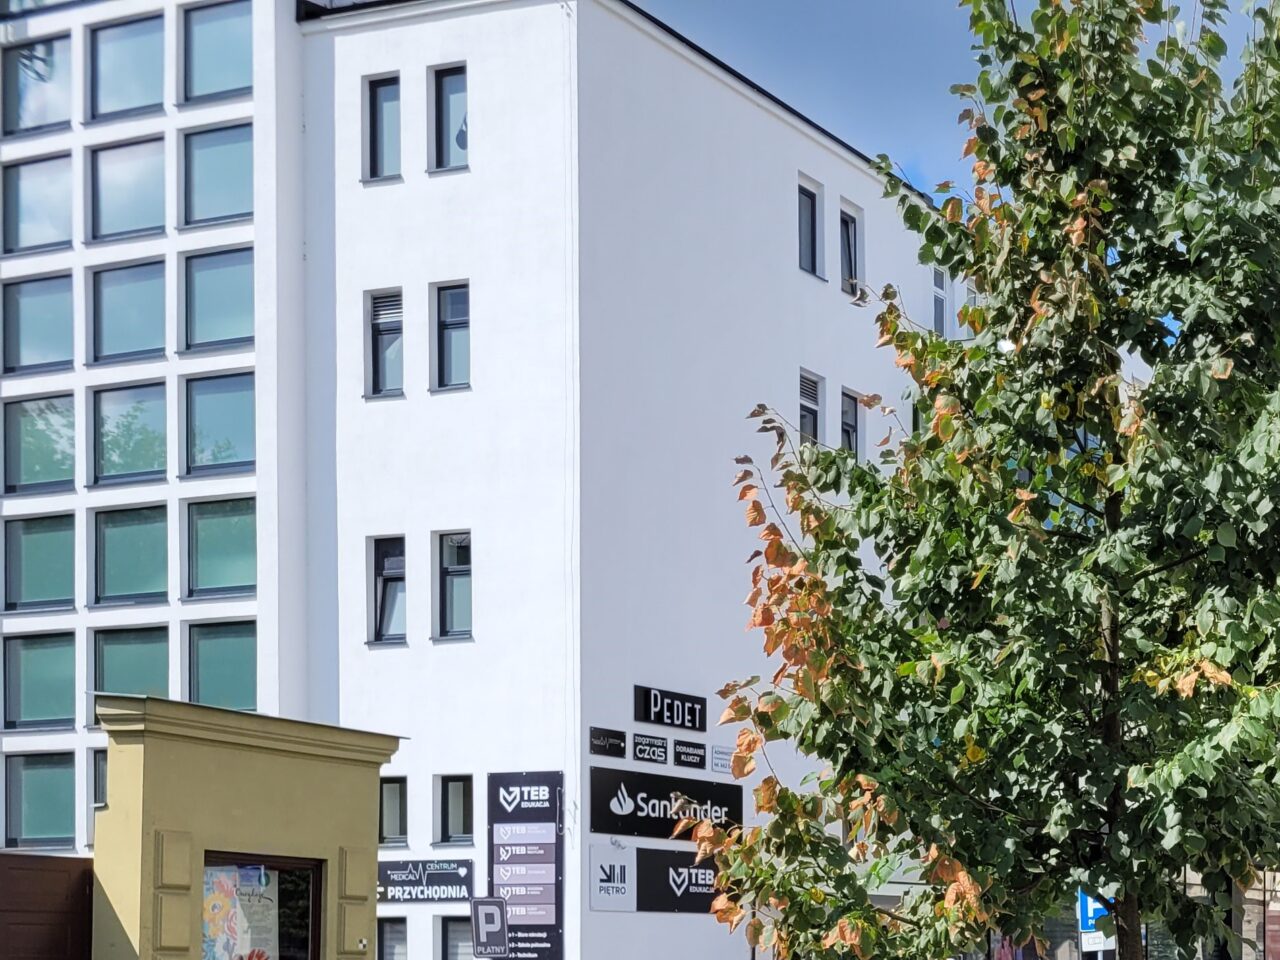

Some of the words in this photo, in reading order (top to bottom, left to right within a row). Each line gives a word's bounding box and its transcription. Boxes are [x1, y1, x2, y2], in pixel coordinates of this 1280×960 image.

[650, 688, 701, 729] PEDET
[681, 754, 701, 763] KLUCZY
[521, 785, 550, 801] TEB
[512, 846, 526, 854] TEB
[426, 863, 458, 871] CENTRUM
[512, 866, 526, 875] TEB
[390, 873, 416, 881] MEDICAL
[689, 868, 714, 884] TEB
[387, 885, 469, 900] PRZYCHODNIA
[512, 886, 526, 895] TEB
[599, 886, 627, 897] PIĘTRO
[689, 885, 715, 894] EDUKACJA
[512, 907, 526, 915] TEB
[478, 905, 502, 942] P
[477, 945, 506, 954] PŁATNY
